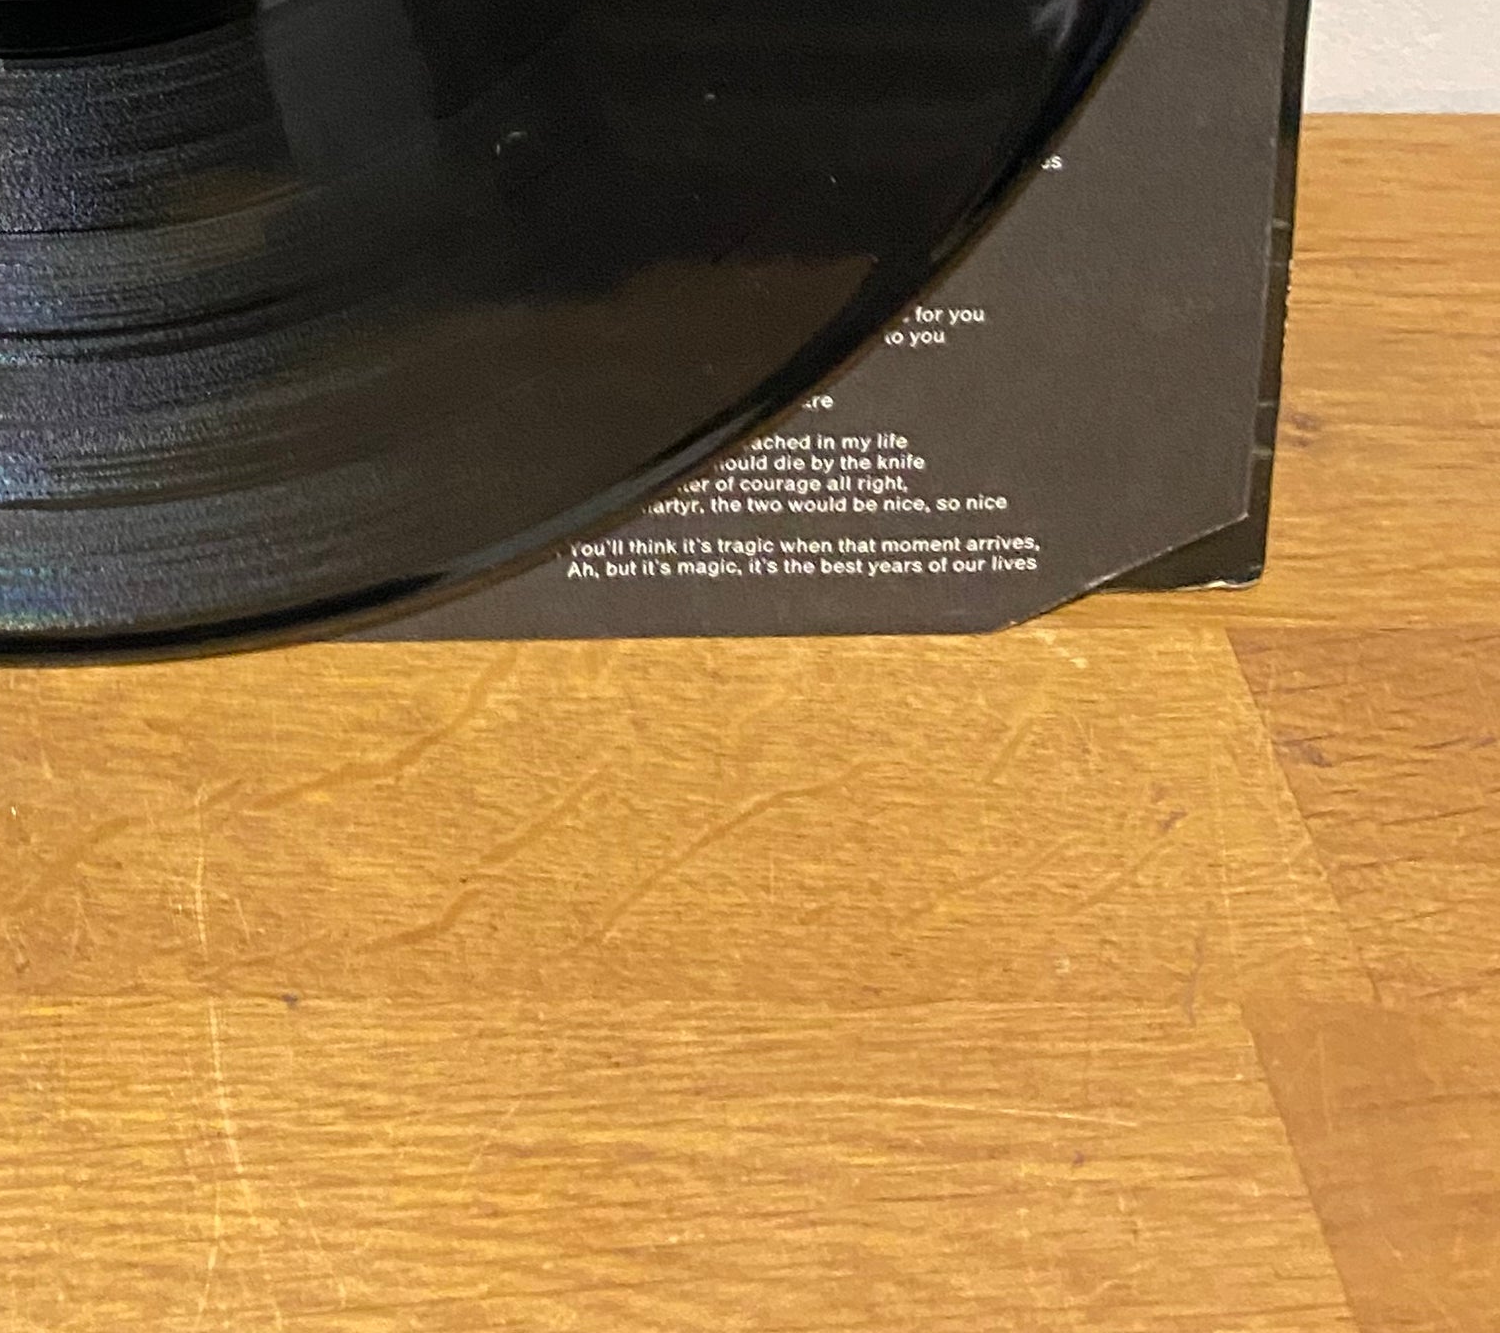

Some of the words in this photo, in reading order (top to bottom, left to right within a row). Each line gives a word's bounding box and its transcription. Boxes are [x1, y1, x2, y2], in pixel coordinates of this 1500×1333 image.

[628, 538, 677, 555] think
[682, 537, 712, 554] it's
[716, 537, 774, 557] tragic
[779, 536, 833, 554] when
[837, 537, 876, 553] that
[880, 536, 961, 553] moment
[965, 534, 1040, 552] arrives,
[566, 560, 600, 579] Ah,
[605, 560, 637, 577] but
[642, 558, 672, 576] it's
[677, 557, 743, 578] magic,
[748, 557, 779, 575] it's
[783, 558, 816, 574] the
[820, 557, 863, 574] best
[867, 559, 923, 577] years
[927, 556, 948, 573] of
[952, 558, 986, 573] our
[991, 554, 1038, 571] lives
